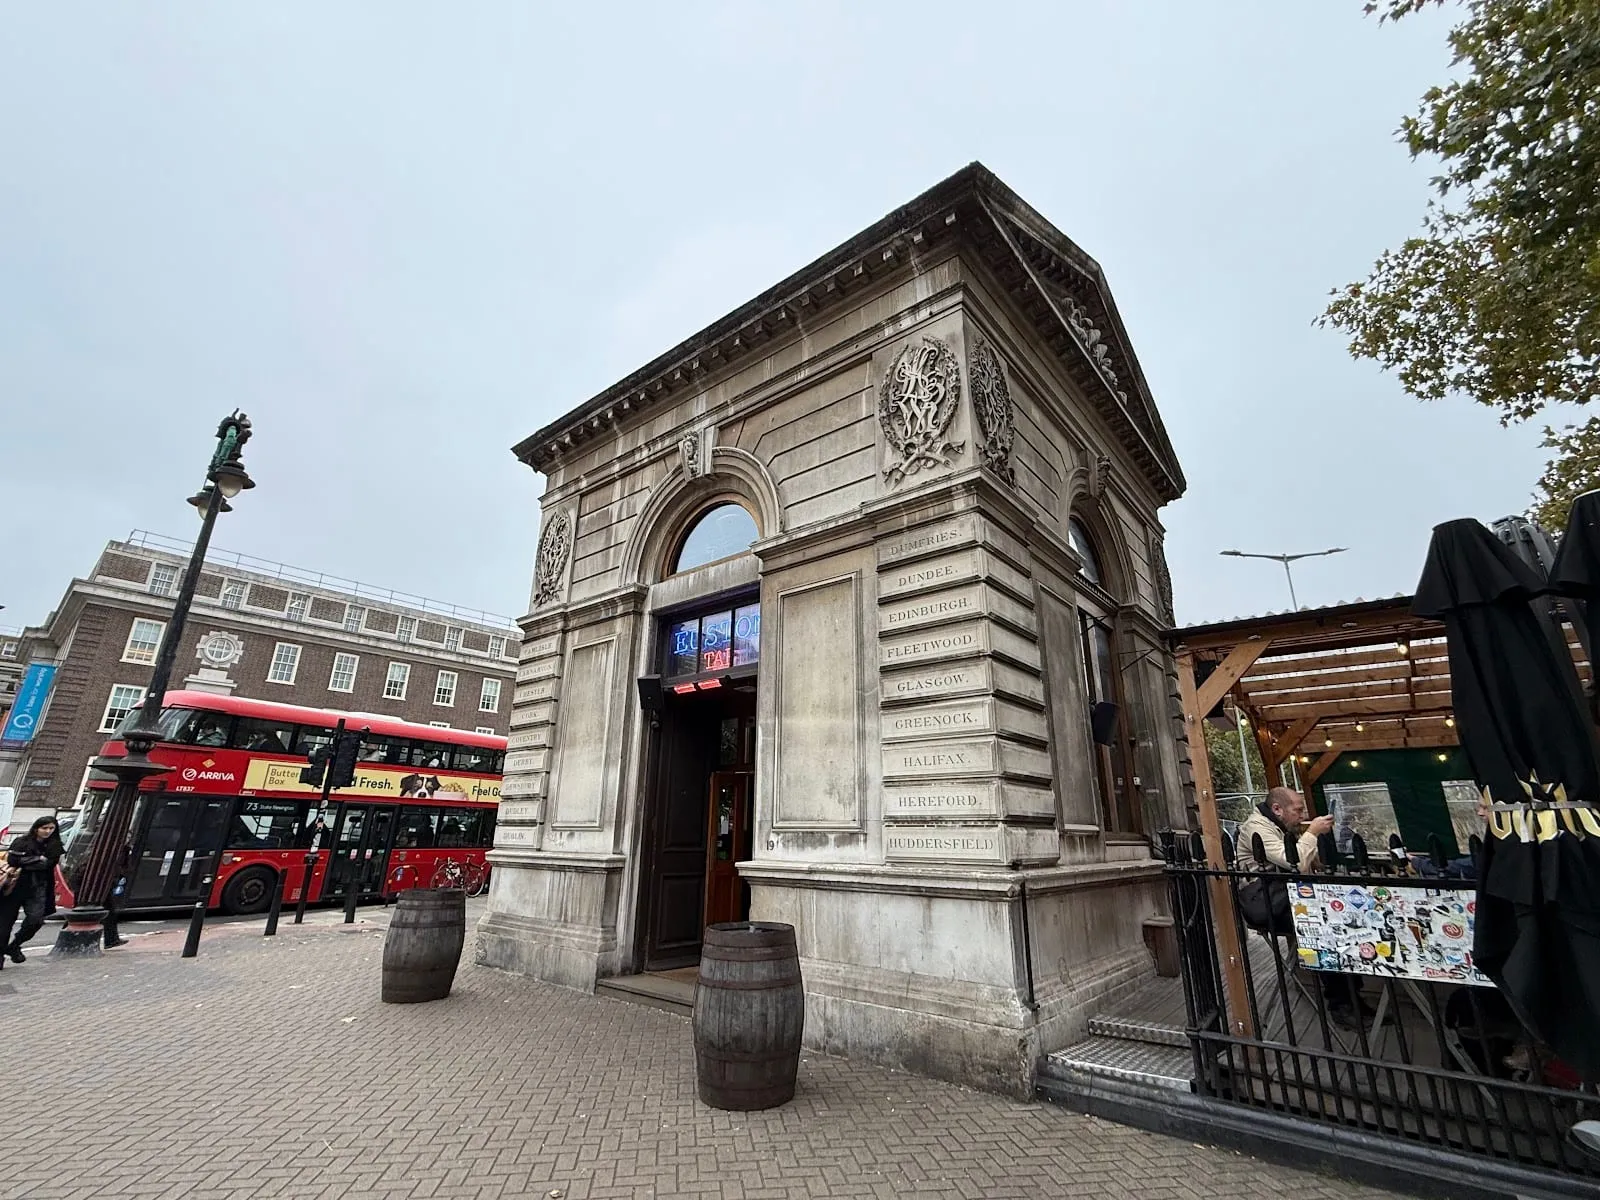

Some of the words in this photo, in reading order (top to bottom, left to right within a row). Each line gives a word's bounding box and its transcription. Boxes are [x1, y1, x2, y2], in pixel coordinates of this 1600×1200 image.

[891, 529, 962, 555] DUMFRIES.
[898, 565, 958, 587] DUNDEE.
[888, 597, 972, 623] EDINBURGH.
[887, 634, 976, 658] FLEETWOOD.
[897, 673, 969, 692] GLASGOW.
[895, 712, 977, 730] GREENOCK.
[904, 753, 971, 767] HALIFAX.
[198, 771, 235, 781] ARRIVA
[268, 776, 285, 785] Box
[359, 776, 394, 790] Fresh.
[472, 785, 491, 796] Feel
[246, 803, 259, 811] 73
[899, 795, 983, 808] HEREFORD.
[889, 838, 993, 850] HUDDERSFIELD
